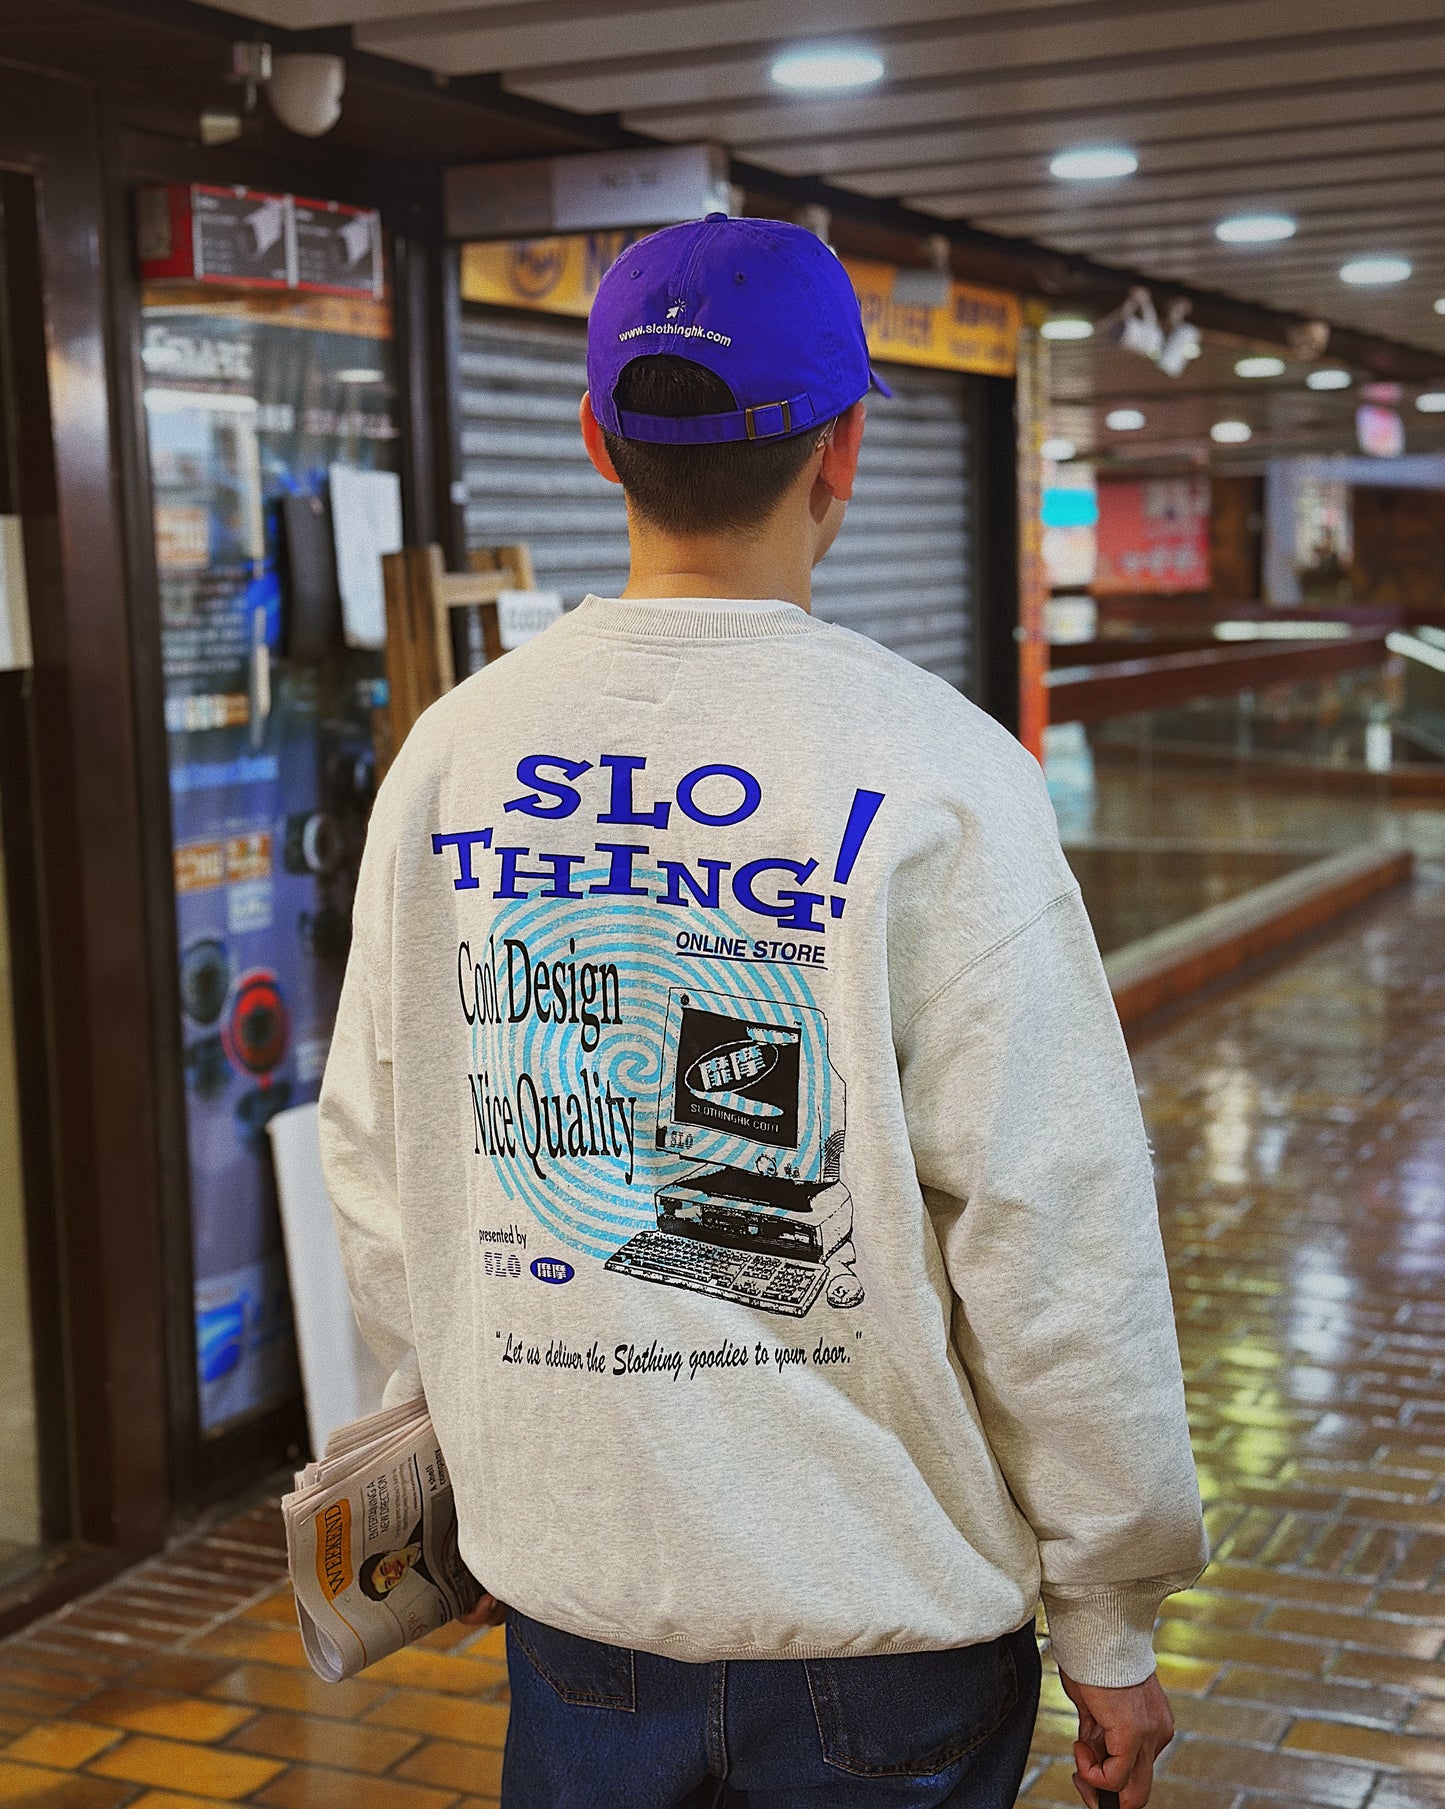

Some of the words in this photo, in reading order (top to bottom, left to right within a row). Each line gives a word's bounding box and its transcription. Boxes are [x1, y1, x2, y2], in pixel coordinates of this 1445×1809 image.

[618, 323, 732, 347] www.slothinghk.com
[503, 754, 762, 830] SLO
[676, 931, 747, 957] ONLINE
[753, 940, 826, 964] STORE
[458, 934, 503, 1026] Cool
[503, 937, 624, 1053] Design
[468, 1070, 516, 1158] Nice
[516, 1067, 637, 1186] Quality
[479, 1224, 514, 1245] presented
[514, 1224, 527, 1250] by
[526, 1346, 541, 1366] us
[545, 1339, 584, 1370] deliver
[586, 1340, 606, 1373] the
[612, 1339, 684, 1382] Slothing
[689, 1338, 749, 1381] goodies
[754, 1341, 770, 1366] to
[774, 1346, 808, 1374] your
[425, 1464, 437, 1483] shell
[324, 1504, 346, 1596] WEEKEND
